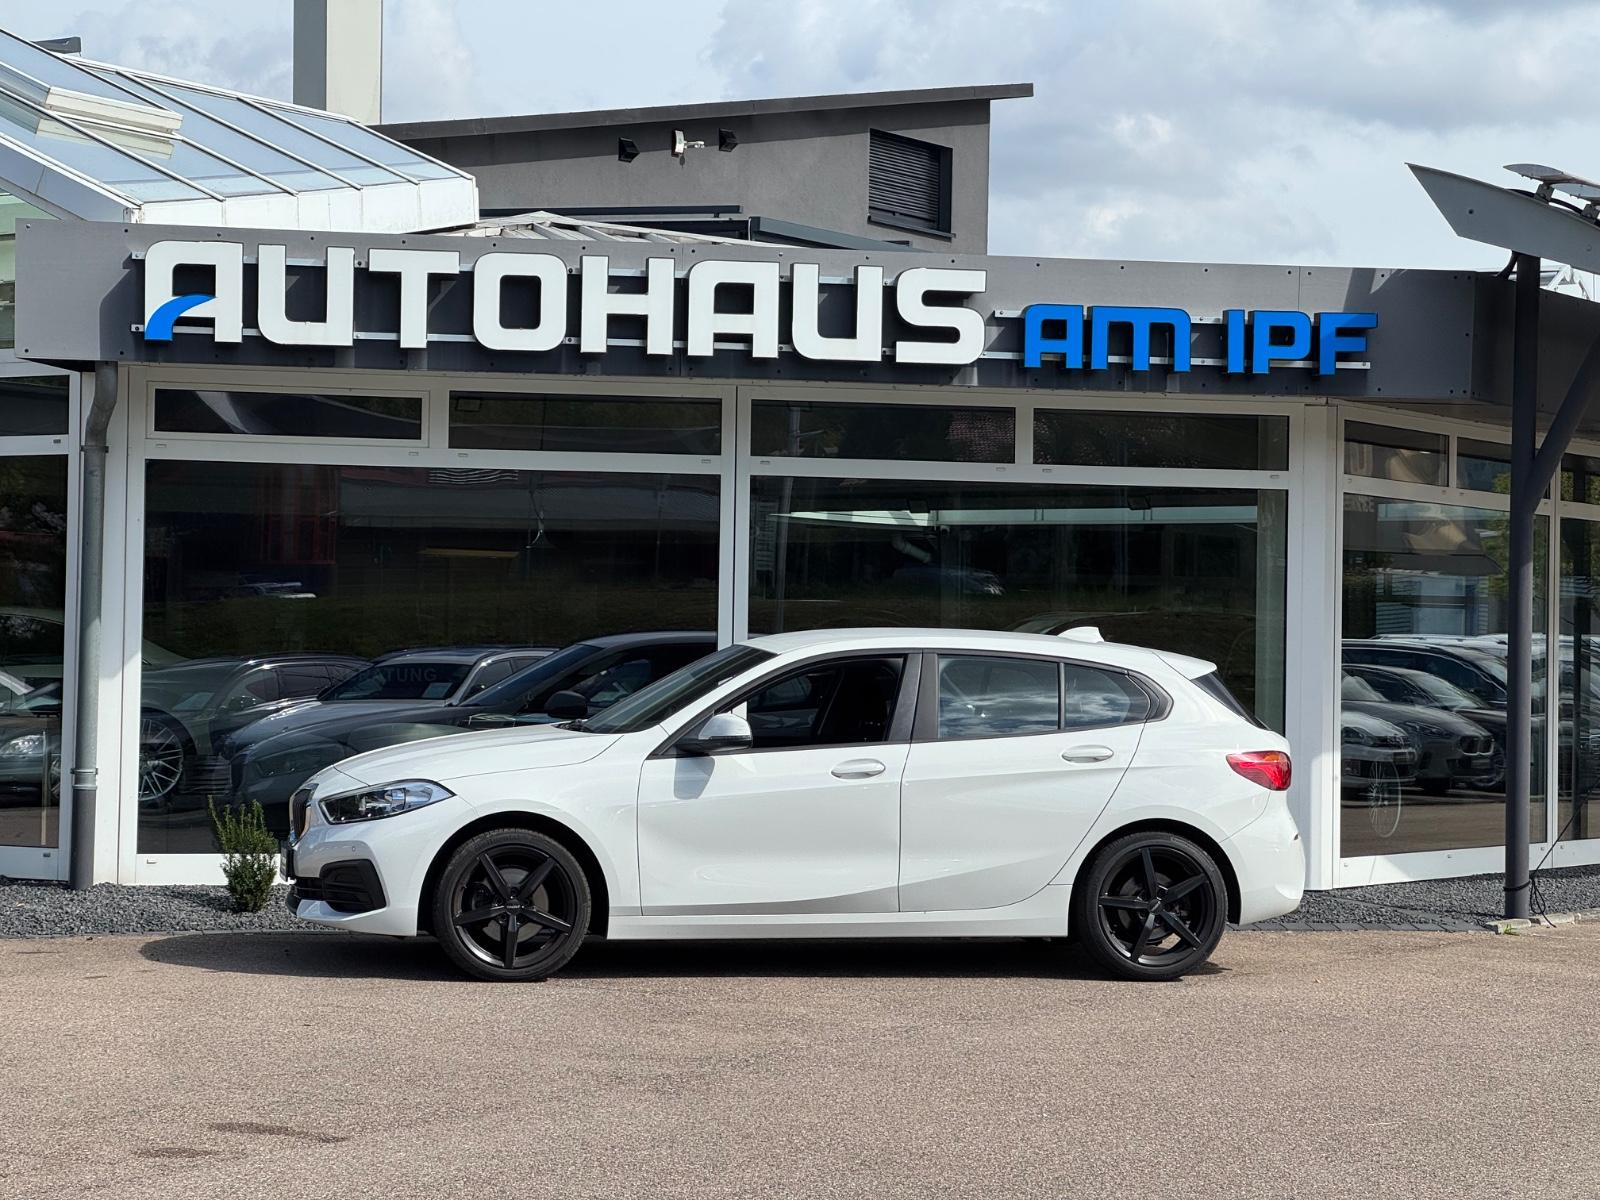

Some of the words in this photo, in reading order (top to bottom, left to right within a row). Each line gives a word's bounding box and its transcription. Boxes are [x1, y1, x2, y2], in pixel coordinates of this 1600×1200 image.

[143, 241, 987, 365] AUTOHAUS
[1023, 303, 1193, 372] AM
[1226, 309, 1378, 376] IPF
